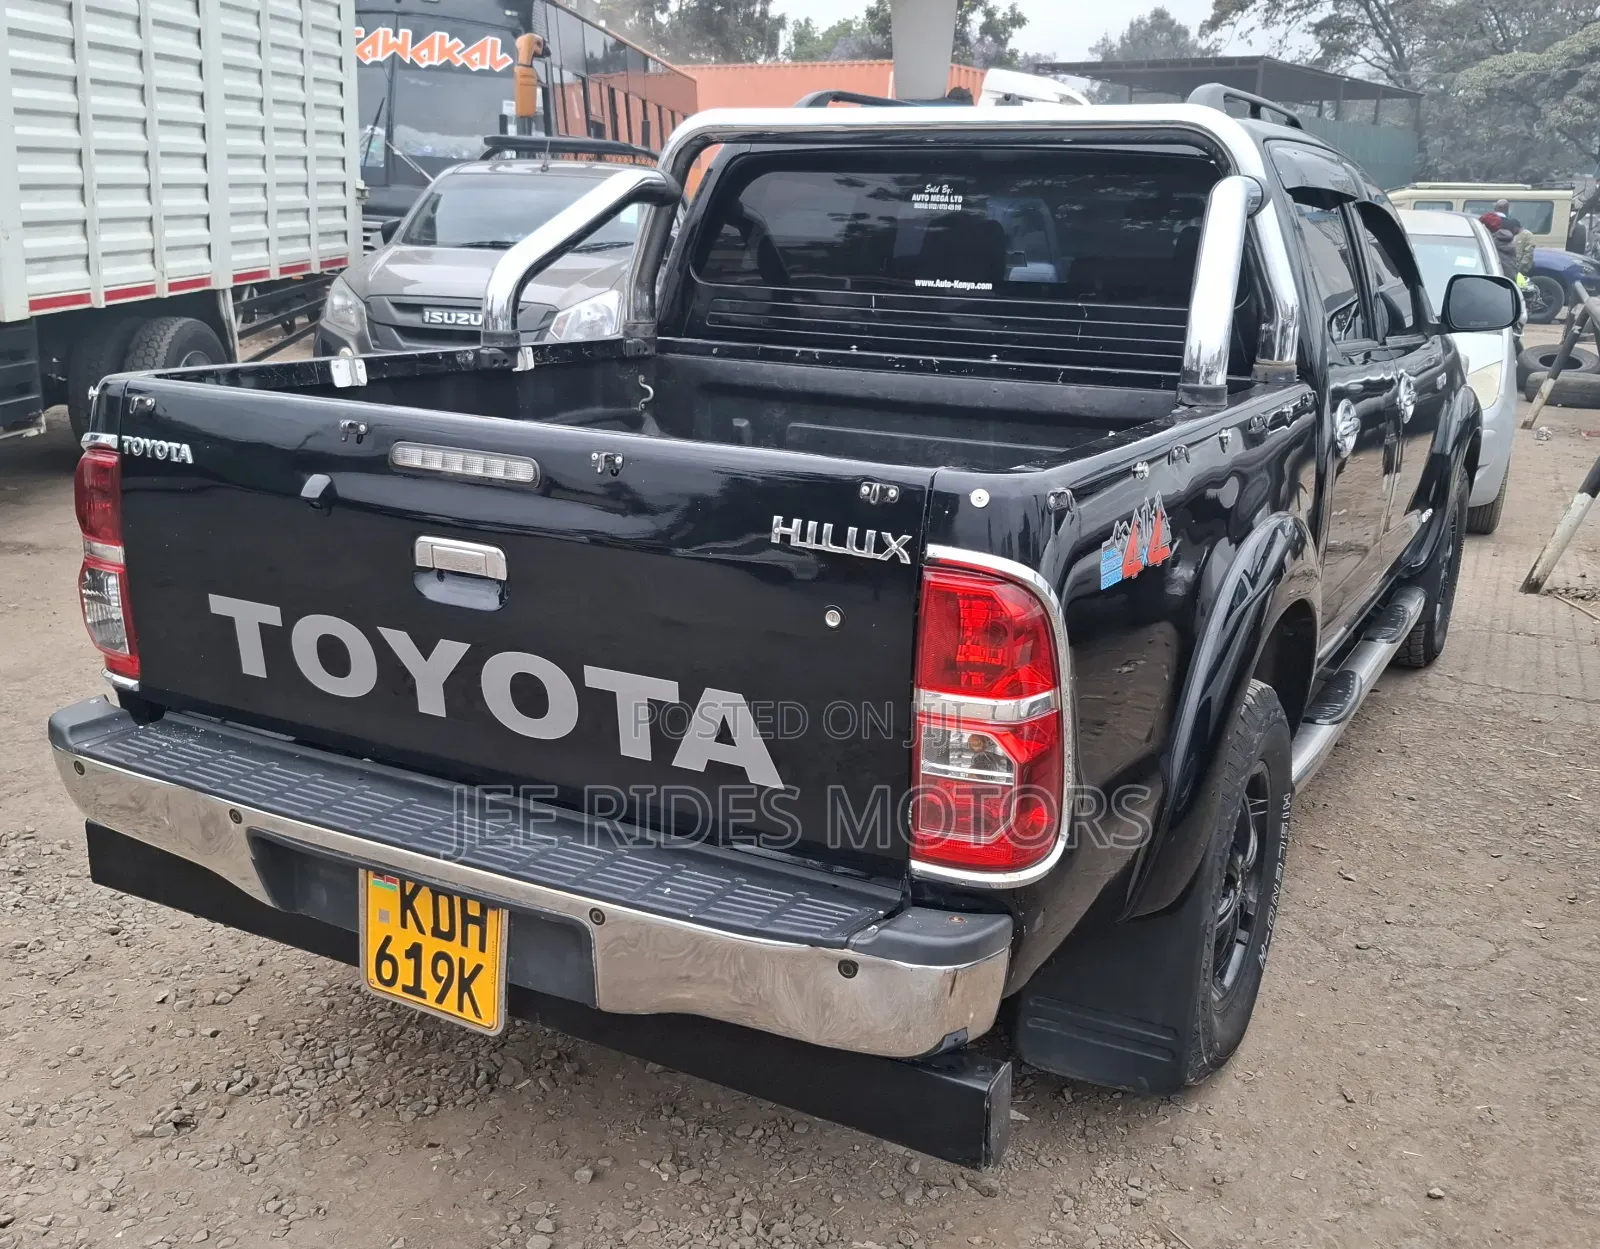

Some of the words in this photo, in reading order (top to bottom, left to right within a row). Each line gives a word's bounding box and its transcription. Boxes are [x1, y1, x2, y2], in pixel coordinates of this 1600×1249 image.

[912, 193, 930, 202] AUTO
[930, 194, 949, 203] MEGA
[950, 195, 963, 203] LTD
[924, 183, 940, 194] Sold
[914, 279, 993, 291] www.Auto-Kenya.com
[423, 309, 483, 325] ISUZU
[122, 435, 194, 464] TOYOTA
[771, 515, 913, 565] HILUX
[208, 593, 785, 791] TOYOTA
[400, 880, 489, 954] KDH
[375, 934, 484, 1020] 619K
